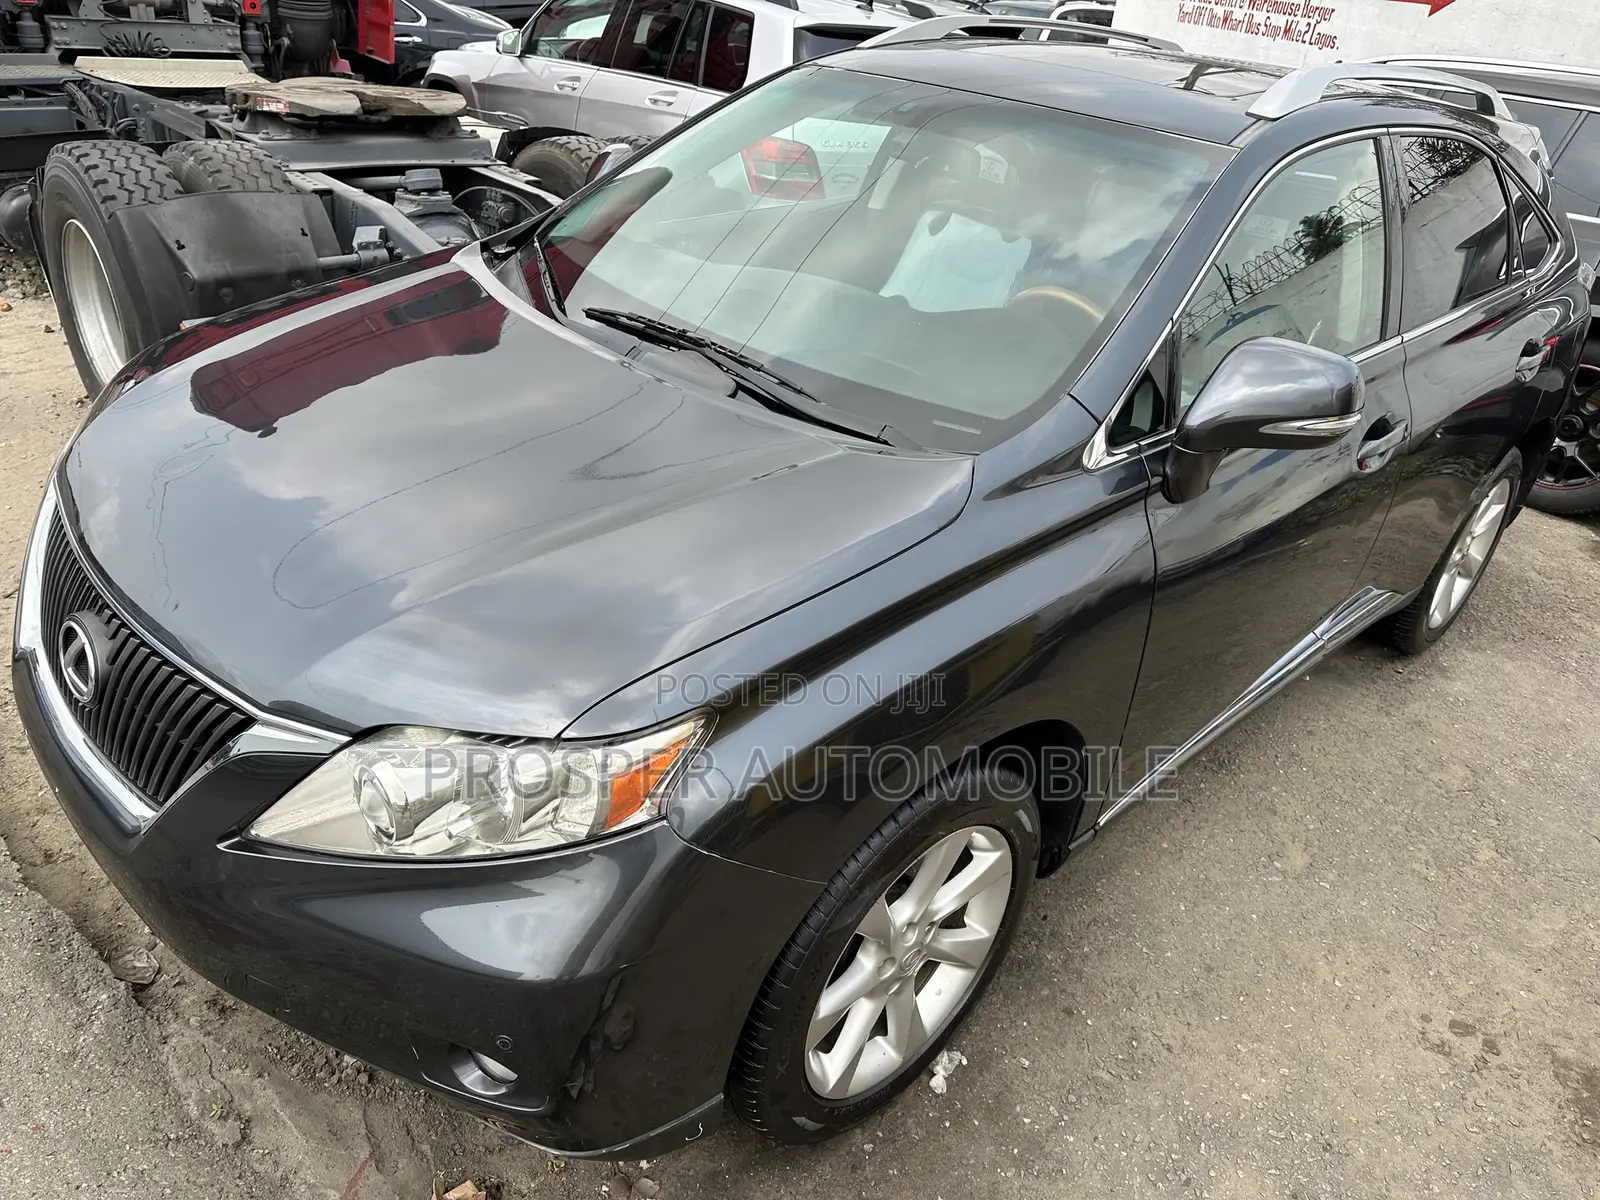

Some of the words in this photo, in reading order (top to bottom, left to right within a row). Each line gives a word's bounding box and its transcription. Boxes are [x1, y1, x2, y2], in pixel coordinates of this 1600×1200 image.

[1177, 3, 1195, 24] Yard
[1221, 9, 1248, 33] Wharf
[1244, 12, 1262, 36] Bus
[1261, 15, 1282, 42] Stop
[1281, 18, 1302, 43] Mile
[1300, 21, 1312, 45] 2
[1301, 0, 1336, 24] Berger
